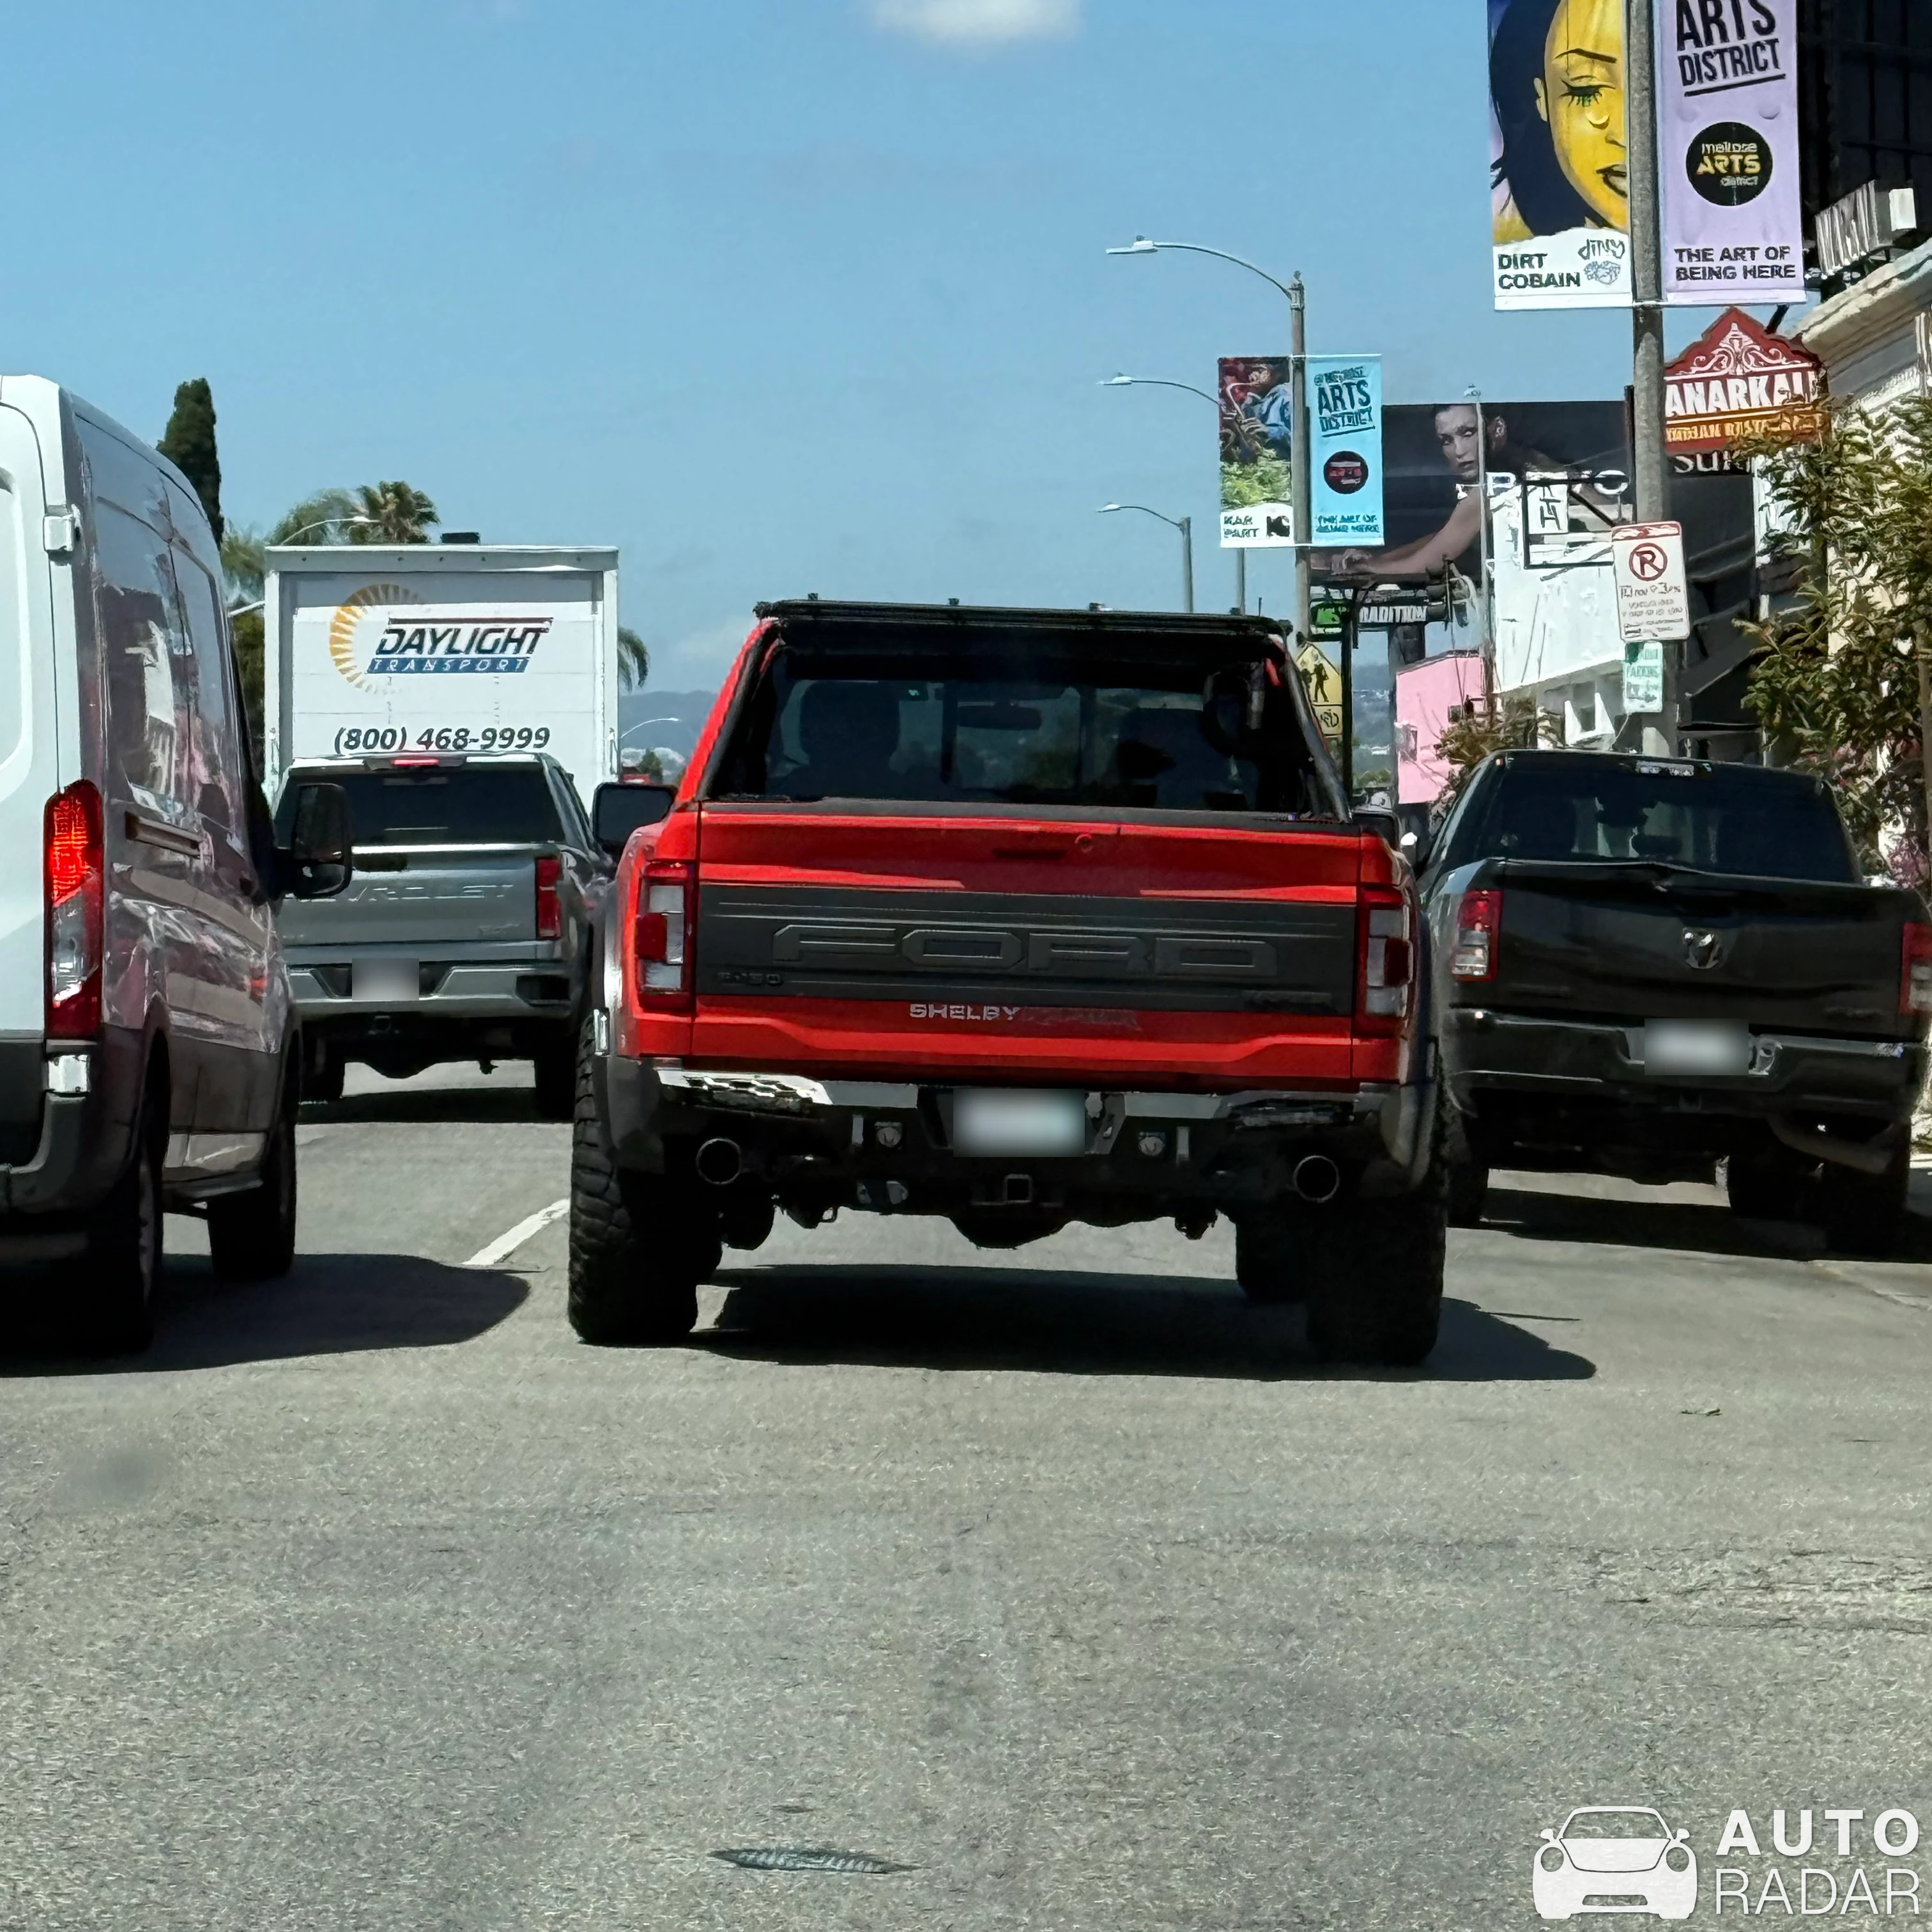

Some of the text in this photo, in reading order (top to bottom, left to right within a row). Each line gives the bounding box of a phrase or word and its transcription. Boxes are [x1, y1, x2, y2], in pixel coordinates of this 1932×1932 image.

[1676, 0, 1775, 51] ARTS
[1678, 38, 1781, 86] DISTRICT
[1696, 154, 1761, 174] ARTS
[1498, 253, 1548, 270] DIRT
[1674, 246, 1791, 263] THE ART OF
[1499, 272, 1581, 289] COBAIN
[1675, 264, 1797, 281] BEING HERE
[1318, 379, 1371, 415] ARTS
[376, 627, 549, 656] DAYLIGHT
[372, 657, 532, 672] TRANSPORT
[334, 726, 551, 755] (800) 468-9999
[773, 924, 1278, 977] FORD
[910, 1003, 1022, 1021] SHELBY
